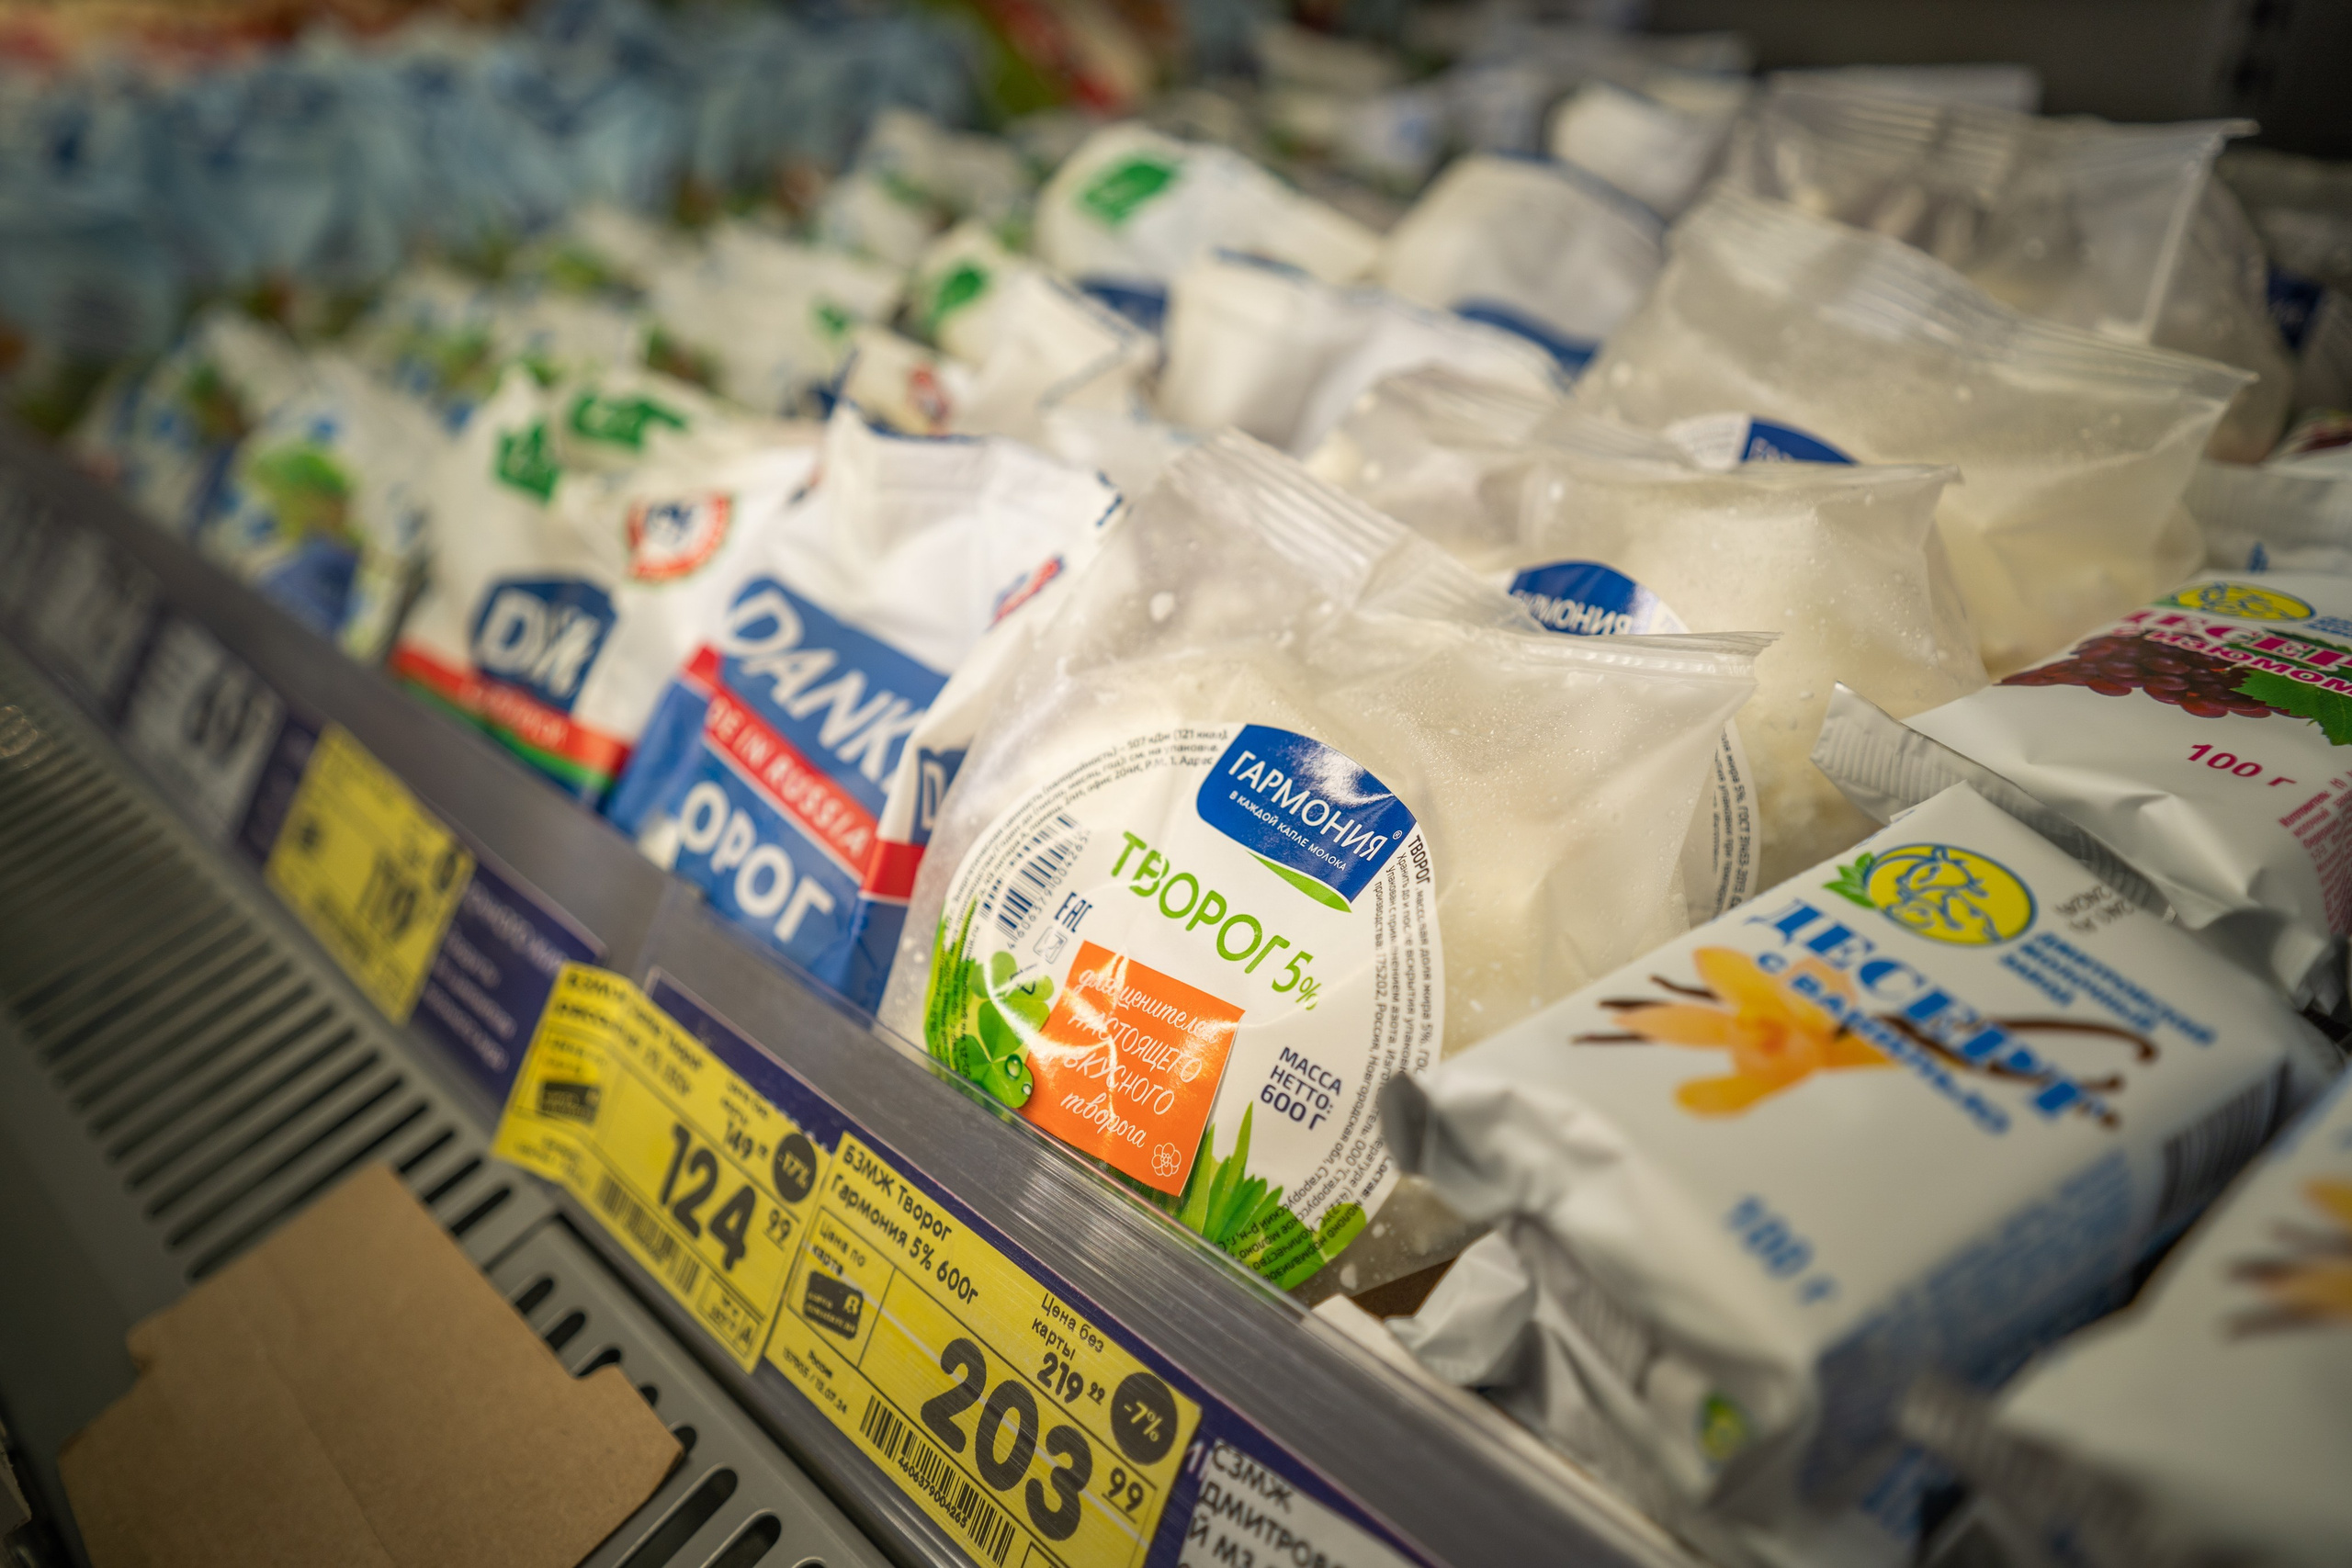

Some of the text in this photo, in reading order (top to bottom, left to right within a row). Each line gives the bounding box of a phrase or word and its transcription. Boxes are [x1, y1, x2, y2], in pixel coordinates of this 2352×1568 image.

[2187, 743, 2262, 778] 100
[763, 752, 871, 858] RUSSIA
[1228, 750, 1388, 862] ГАРМОНИЯ
[1228, 790, 1347, 871] В КАЖДОЙ КАПЛЕ МОЛОКА
[1386, 865, 1396, 907] Упакован
[1396, 852, 1409, 888] Хранить
[1402, 889, 1410, 901] до
[1111, 830, 1322, 1010] ТВОРОГ 5%
[1406, 950, 1416, 1014] вскрытия
[1421, 985, 1432, 1020] жира
[1746, 897, 2106, 1121] ДЕСЕРТ
[1068, 1010, 1203, 1083] НАСТОЯЩЕГО
[1279, 1046, 1341, 1096] МАССА
[1060, 1092, 1148, 1148] творога
[1261, 1084, 1306, 1122] 600
[1270, 1065, 1333, 1114] НЕТТО:
[1340, 1055, 1378, 1143] Новгородская
[660, 1122, 756, 1271] 124
[767, 1209, 791, 1243] 99
[843, 1145, 952, 1241] БЗМЖ Творог
[1261, 1167, 1329, 1230] Старорусский
[1327, 1200, 1363, 1238] молоко
[820, 1221, 865, 1267] Цена по
[831, 1173, 978, 1304] Гармония 5% 600г
[1252, 1224, 1317, 1271] Количество
[1032, 1318, 1076, 1360] карты
[1041, 1292, 1104, 1353] Цена без
[1036, 1352, 1106, 1404] 219 99
[921, 1337, 1145, 1541] 203 99
[1124, 1401, 1163, 1441] -7%
[898, 1456, 968, 1529] 4606379004265
[1212, 1443, 1294, 1514] СЗМЖ
